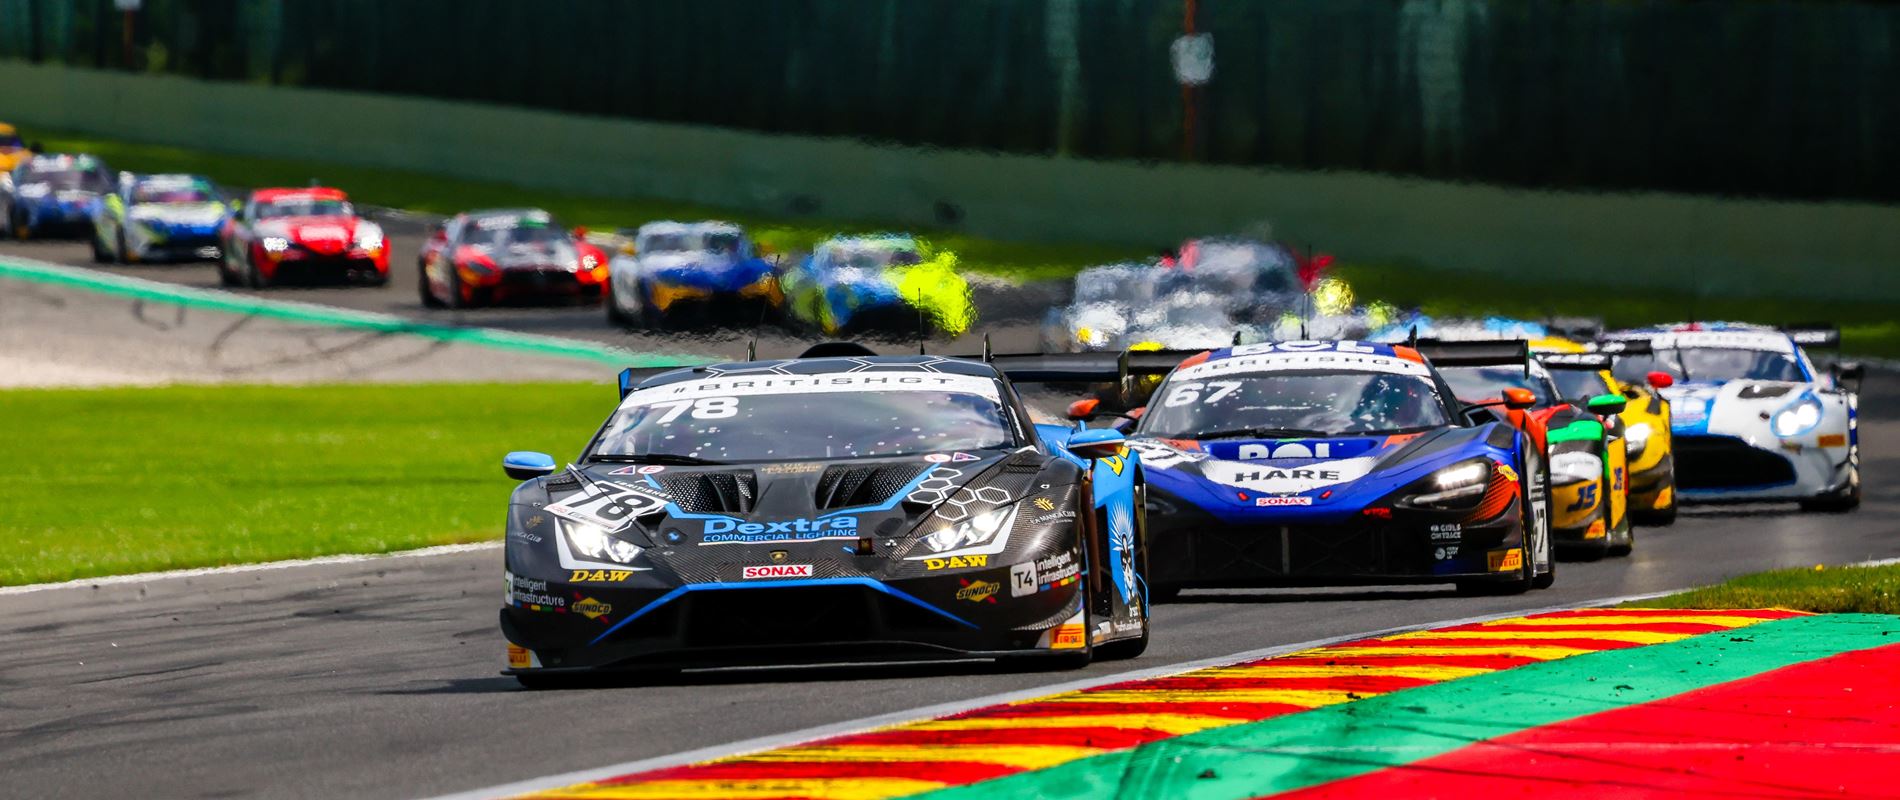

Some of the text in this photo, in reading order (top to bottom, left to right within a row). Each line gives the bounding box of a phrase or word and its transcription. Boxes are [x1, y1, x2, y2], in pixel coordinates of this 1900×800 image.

[1165, 381, 1242, 408] 67
[651, 396, 739, 424] 78
[1234, 470, 1340, 482] HARE
[565, 482, 656, 521] 78
[703, 516, 858, 535] Dextra
[703, 529, 857, 542] COMMERCIAL LIGHTING
[745, 566, 808, 578] SONAX
[1014, 570, 1034, 588] T4
[957, 583, 999, 599] SUNOCO
[573, 602, 611, 614] SUNOCO
